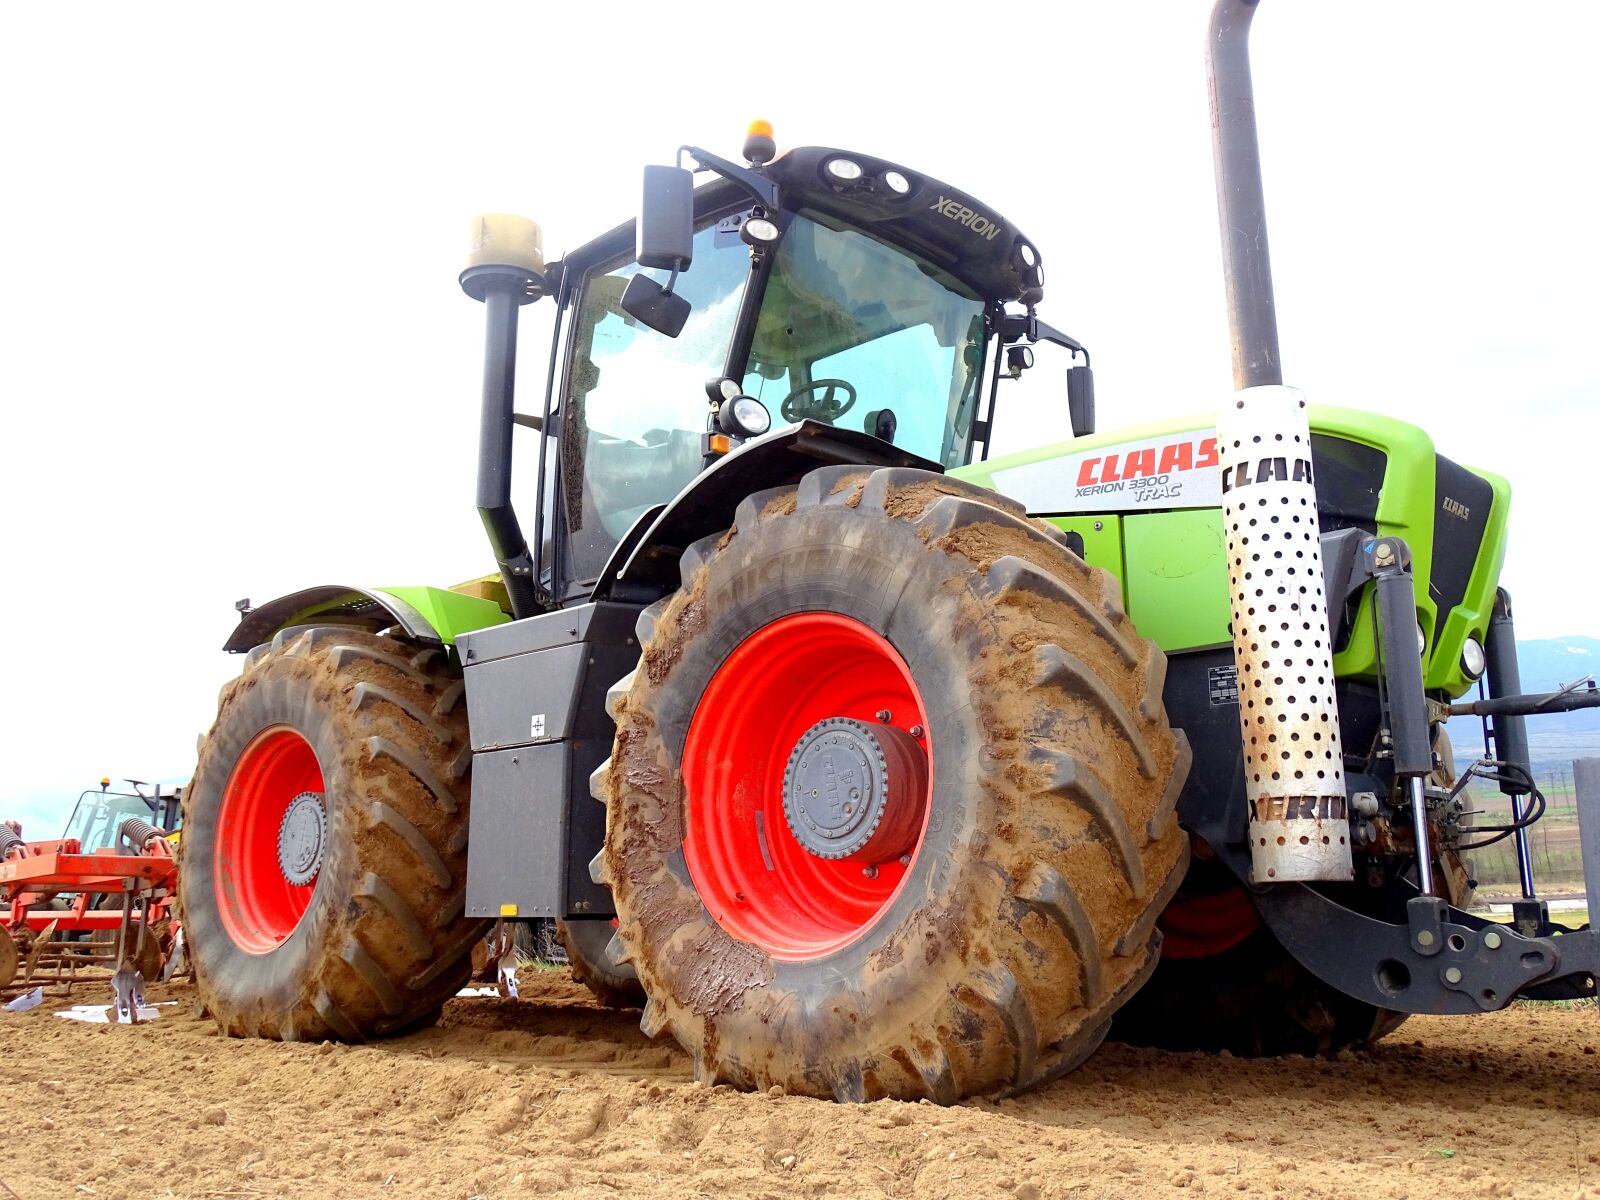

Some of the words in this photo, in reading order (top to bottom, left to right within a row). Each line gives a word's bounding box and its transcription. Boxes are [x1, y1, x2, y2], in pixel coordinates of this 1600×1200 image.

[929, 195, 1001, 241] XERION
[1076, 437, 1219, 487] CLAAS
[1075, 481, 1125, 498] XERION
[1129, 475, 1169, 490] 3300
[1134, 483, 1182, 502] TRAC
